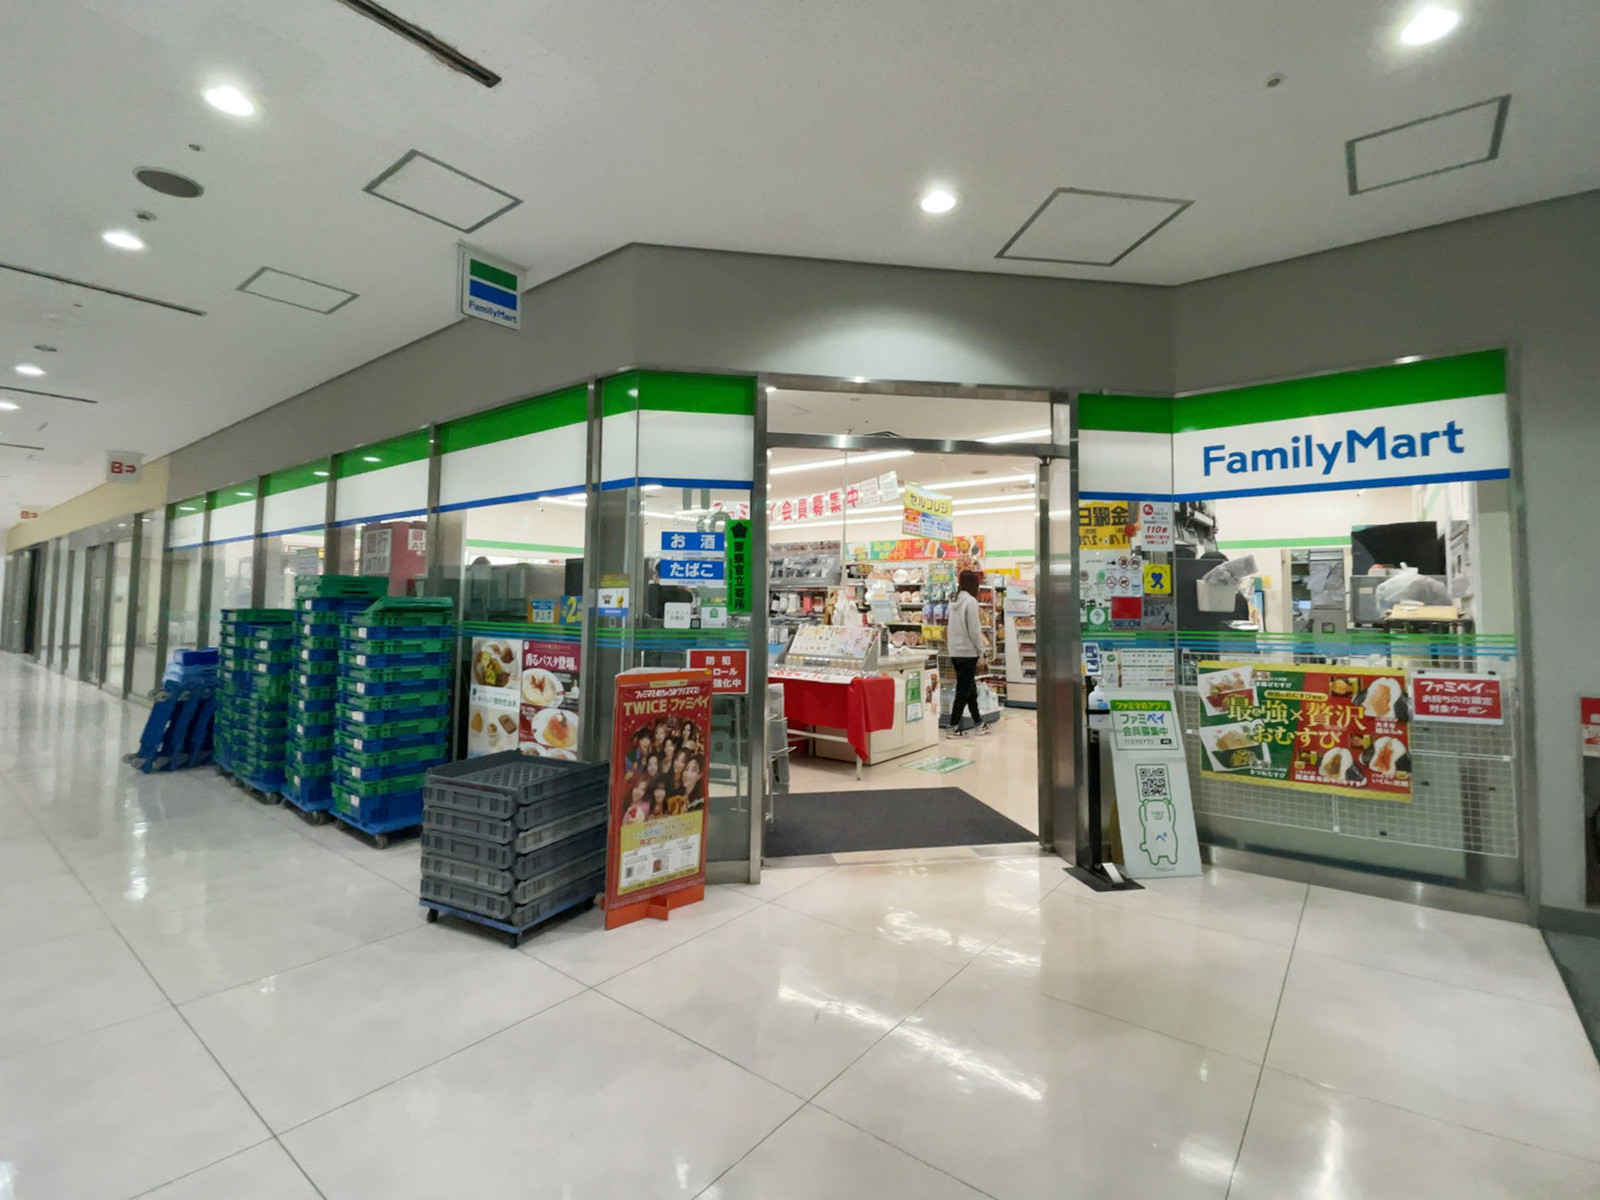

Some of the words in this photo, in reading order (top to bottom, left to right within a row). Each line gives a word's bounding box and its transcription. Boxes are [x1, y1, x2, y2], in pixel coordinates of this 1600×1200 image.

[468, 300, 517, 323] FamilyMart
[1203, 420, 1464, 476] FamilyMart
[110, 461, 123, 474] B
[670, 533, 716, 549] お酒
[670, 562, 714, 577] たばこ
[705, 656, 731, 665] 防犯
[713, 667, 738, 676] ロール
[713, 678, 741, 688] 強化中
[624, 699, 667, 716] TWICE
[670, 695, 710, 712] ファミペイ
[1120, 712, 1165, 725] ファミペイ
[1122, 726, 1168, 737] 会員募集中
[1252, 724, 1342, 749] おむすび
[1155, 832, 1168, 843] ペ
